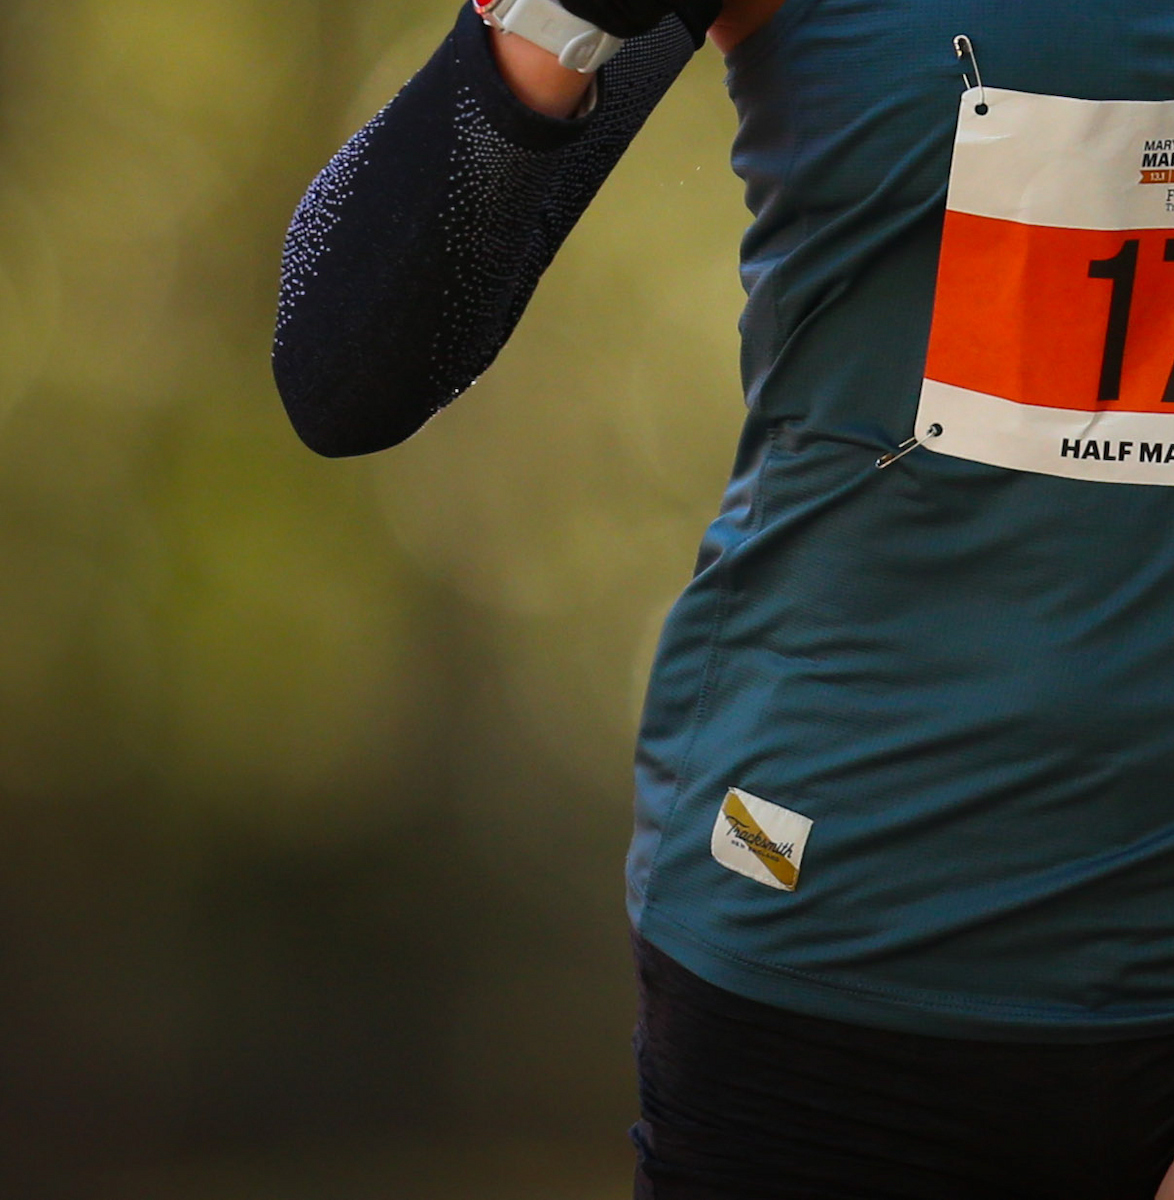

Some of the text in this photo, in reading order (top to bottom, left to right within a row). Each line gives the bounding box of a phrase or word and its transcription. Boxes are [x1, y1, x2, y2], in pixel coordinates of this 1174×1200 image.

[1150, 172, 1165, 181] 13.1
[1061, 438, 1133, 461] HALF
[726, 815, 794, 858] Tracksmith
